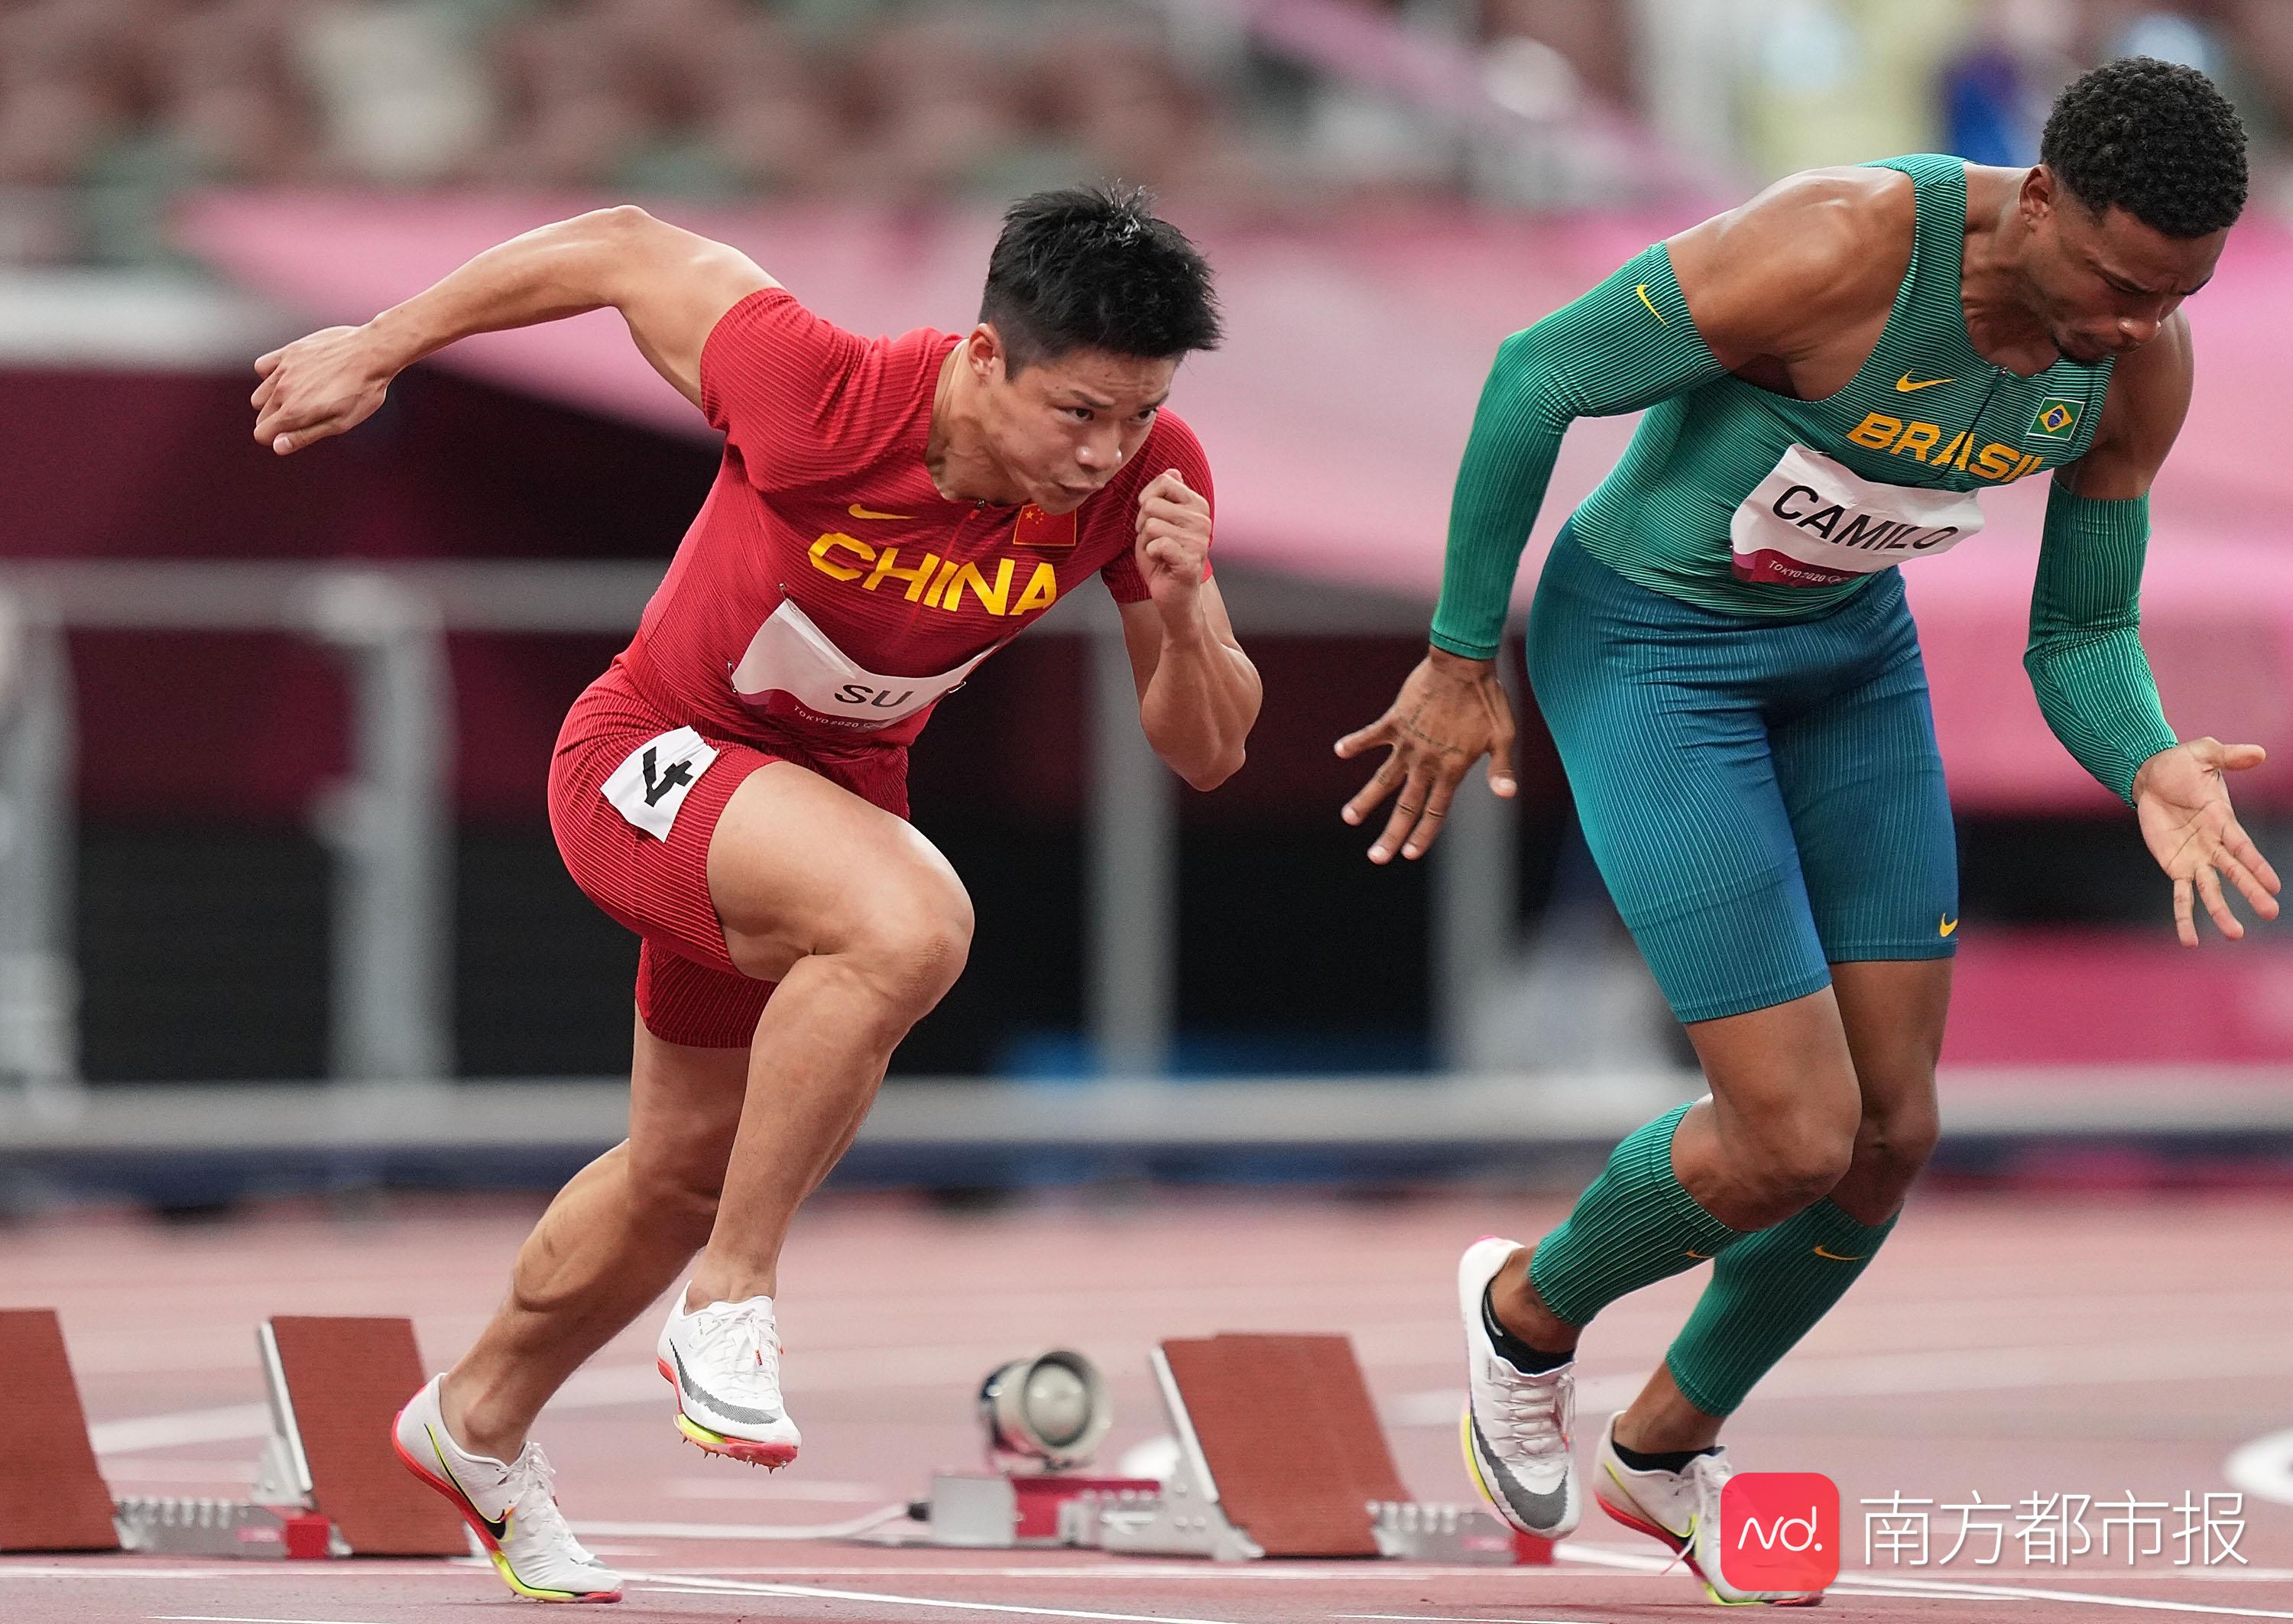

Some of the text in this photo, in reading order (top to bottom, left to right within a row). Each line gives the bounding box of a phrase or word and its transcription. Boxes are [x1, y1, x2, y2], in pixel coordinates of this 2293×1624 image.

[1772, 485, 1959, 551] CAMILO
[807, 532, 1057, 616] CHINA
[1769, 560, 1826, 582] TOKYO 2020
[793, 705, 860, 728] TOKYO 2020
[834, 684, 914, 708] SU
[642, 746, 694, 808] 4
